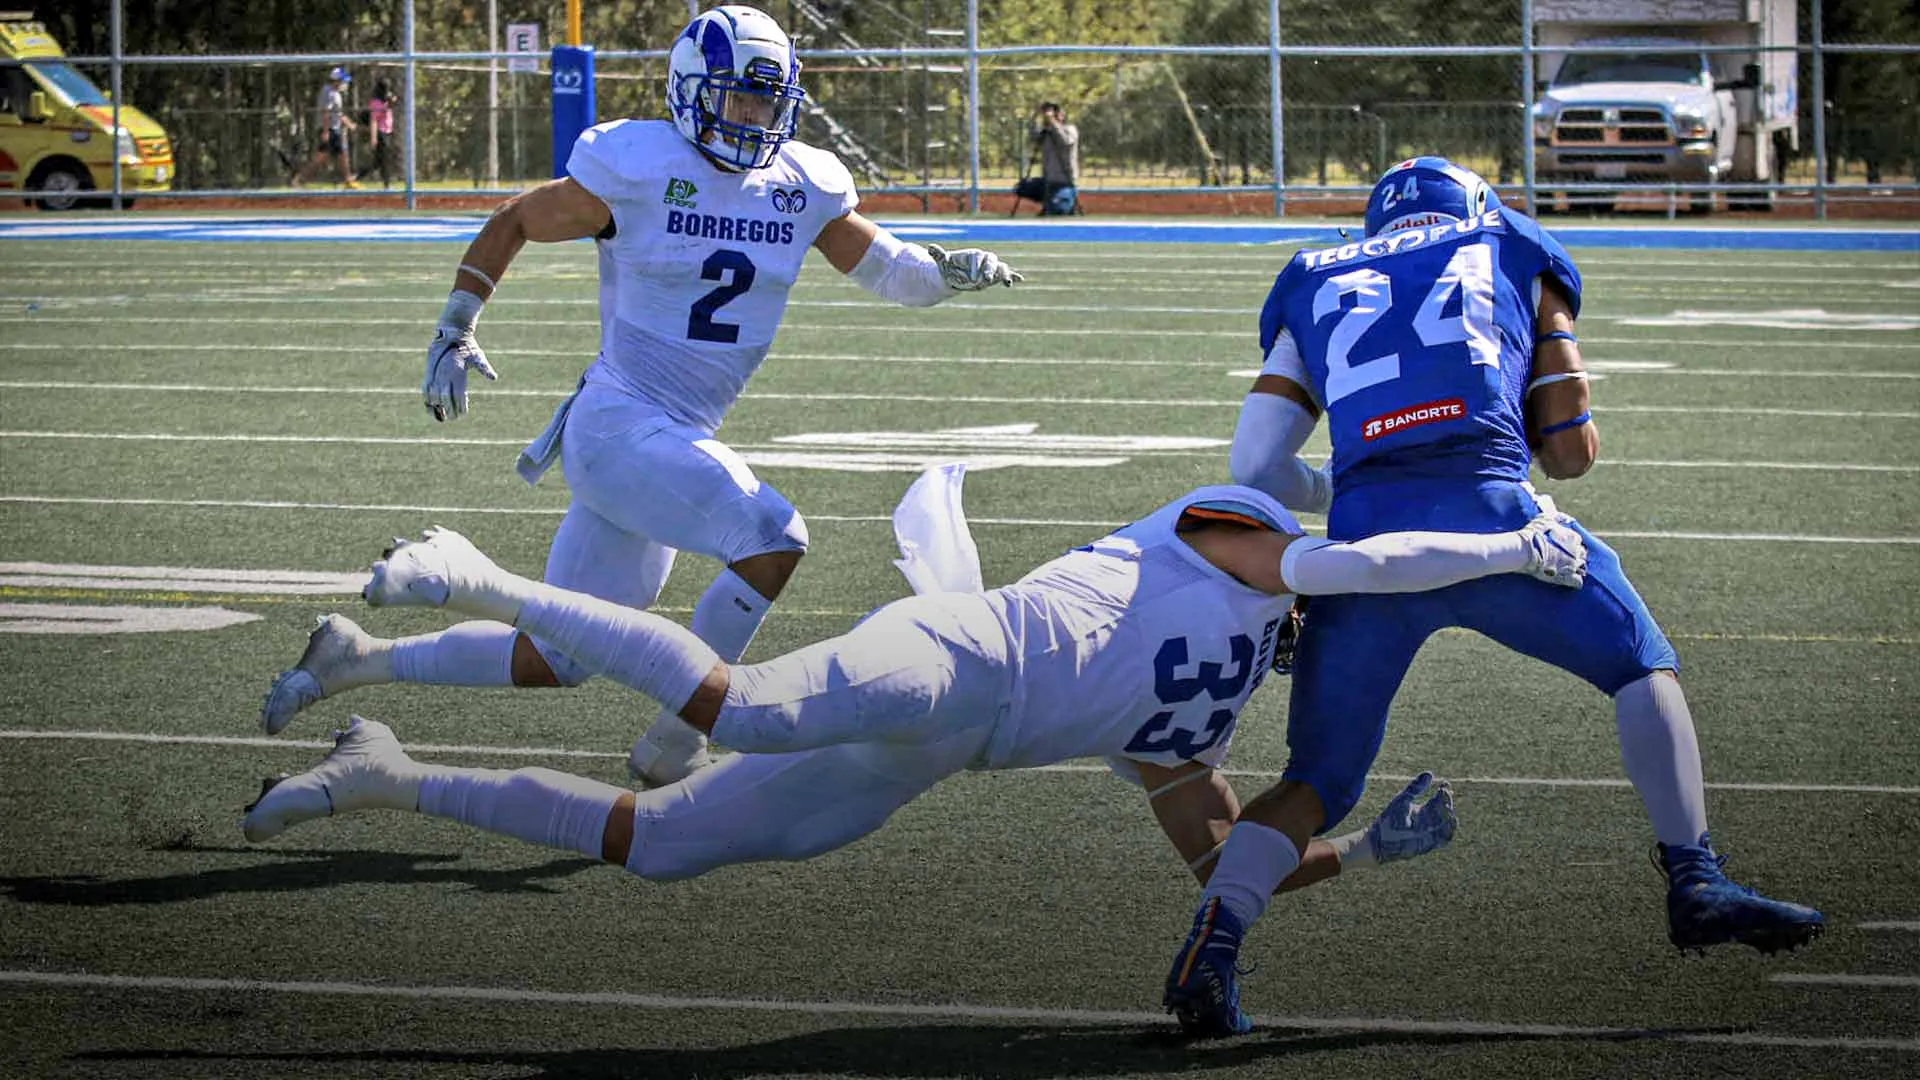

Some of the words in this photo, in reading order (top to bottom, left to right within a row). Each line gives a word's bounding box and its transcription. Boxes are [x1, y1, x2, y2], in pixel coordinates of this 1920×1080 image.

[516, 33, 529, 51] E
[1381, 175, 1420, 212] 24
[666, 210, 794, 245] BORREGOS
[1303, 243, 1360, 269] TEC
[1430, 208, 1501, 242] PUE
[687, 249, 756, 344] 2
[1313, 242, 1500, 407] 24
[1384, 404, 1462, 430] BANORTE
[1124, 633, 1256, 760] 33
